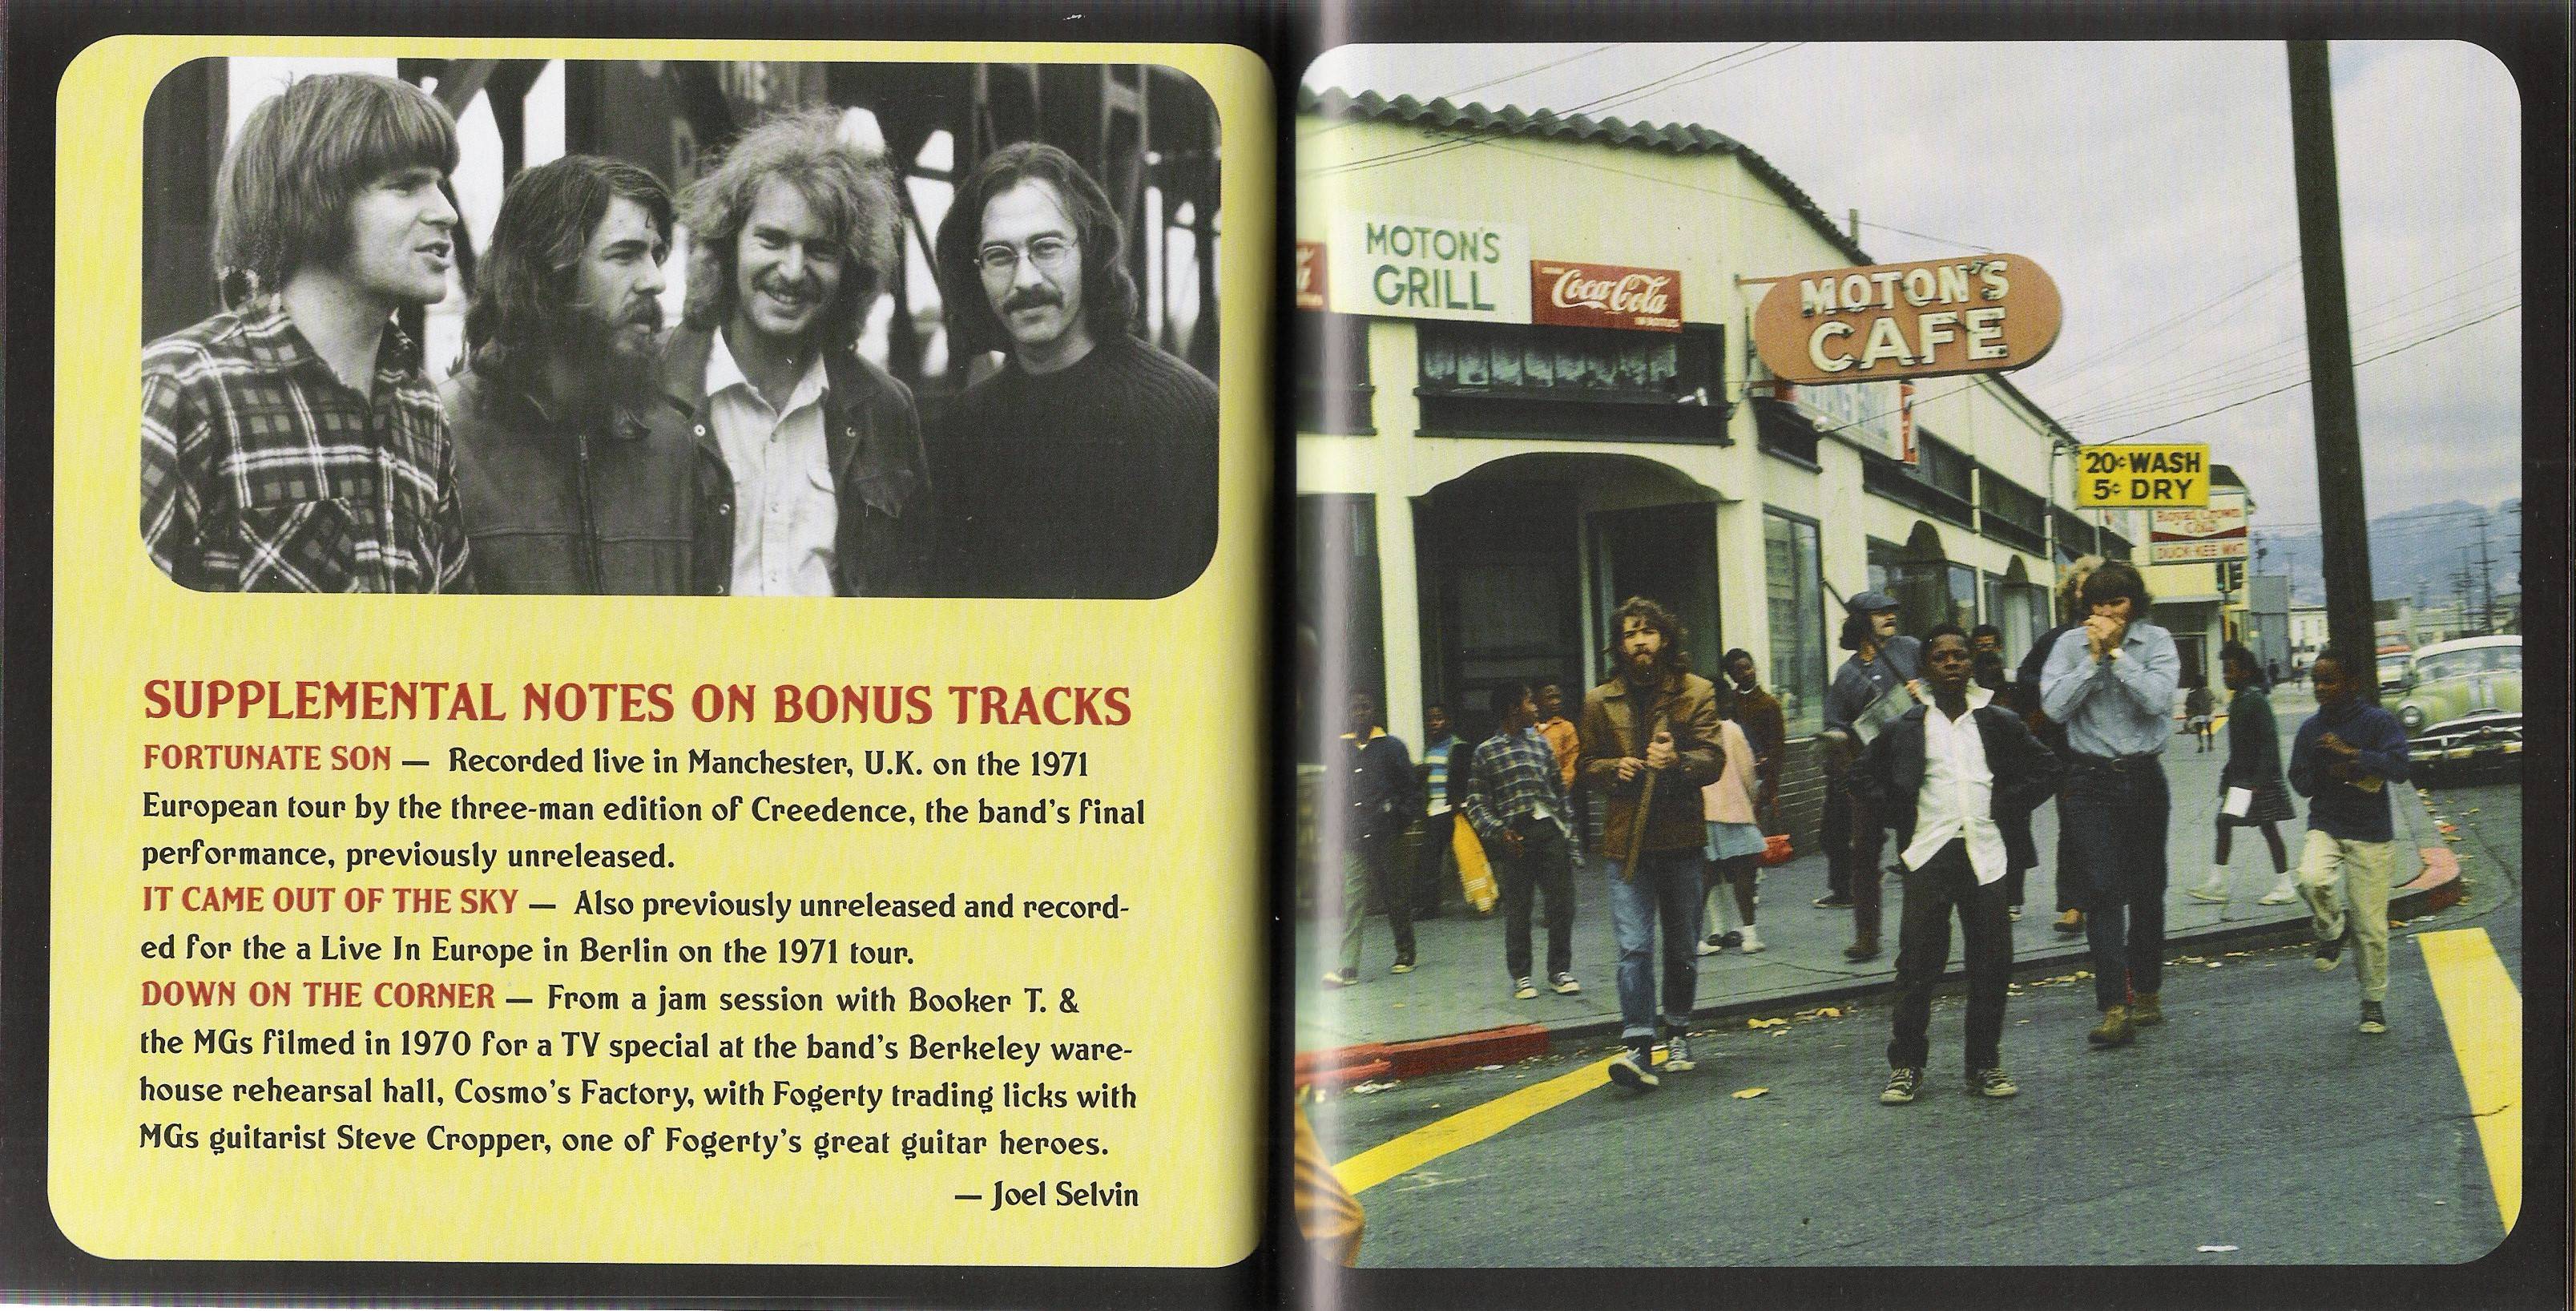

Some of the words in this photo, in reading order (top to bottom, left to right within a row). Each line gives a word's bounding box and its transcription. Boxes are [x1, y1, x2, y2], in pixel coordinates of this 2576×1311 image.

[1366, 222, 1501, 264] MOTON'S
[1373, 264, 1495, 311] GRILL
[1800, 260, 2010, 317] MOTON'S
[1808, 306, 2008, 373] CAFE
[2129, 452, 2200, 474] WASH
[2131, 479, 2193, 500] DRY
[144, 679, 506, 721] SUPPLEMENTAL
[523, 682, 675, 723] NOTES
[691, 684, 756, 723] ON
[774, 684, 933, 724] BONUS
[948, 686, 1131, 726] TRACKS
[144, 744, 321, 771] FORTUNATE
[331, 745, 392, 771] SON
[449, 747, 583, 773] Recorded
[593, 748, 645, 773] live
[653, 748, 678, 774] in
[688, 748, 853, 778] Manchester,
[865, 750, 923, 776] U.K.
[933, 758, 967, 776] on
[978, 750, 1021, 777] the
[1031, 751, 1088, 777] 1971
[143, 791, 278, 825] European
[288, 796, 346, 818] tour
[355, 793, 389, 826] by
[398, 793, 442, 820] the
[451, 793, 595, 821] three-man
[603, 795, 703, 821] edition
[712, 795, 744, 821] of
[752, 796, 915, 826] Creedence,
[925, 797, 970, 823] the
[978, 797, 1070, 825] band's
[1079, 798, 1145, 825] final
[142, 838, 335, 871] performance,
[345, 841, 498, 874] previously
[507, 841, 675, 869] unreleased.
[143, 885, 174, 911] IT
[182, 886, 264, 912] CAME
[273, 887, 336, 913] OUT
[345, 887, 385, 913] OF
[393, 888, 452, 914] THE
[461, 888, 519, 914] SKY
[573, 889, 634, 915] Also
[643, 890, 792, 924] previously
[800, 891, 956, 918] unreleased
[964, 893, 1014, 918] and
[1022, 893, 1130, 919] record-
[140, 934, 175, 959] ed
[186, 933, 232, 959] for
[243, 934, 286, 960] the
[296, 942, 312, 960] a
[321, 934, 382, 961] Live
[393, 935, 421, 961] In
[432, 936, 534, 969] Europe
[543, 936, 568, 962] in
[580, 937, 668, 963] Berlin
[679, 945, 712, 963] on
[724, 938, 768, 963] the
[778, 938, 838, 964] 1971
[850, 942, 913, 965] tour.
[142, 980, 236, 1007] DOWN
[249, 981, 292, 1007] ON
[302, 982, 362, 1008] THE
[374, 982, 496, 1009] CORNER
[548, 984, 619, 1010] From
[631, 992, 647, 1010] a
[655, 984, 707, 1017] jam
[720, 986, 823, 1011] session
[836, 986, 896, 1012] with
[909, 986, 1011, 1013] Booker
[1023, 987, 1046, 1013] T.
[1058, 987, 1080, 1014] &
[140, 1028, 184, 1054] the
[194, 1028, 253, 1055] MGs
[263, 1028, 355, 1055] filmed
[365, 1030, 391, 1055] in
[401, 1030, 471, 1056] 1970
[482, 1030, 528, 1057] for
[537, 1039, 552, 1057] a
[561, 1031, 601, 1058] TV
[609, 1032, 709, 1064] special
[719, 1035, 744, 1059] at
[754, 1032, 797, 1059] the
[806, 1033, 898, 1059] band's
[909, 1034, 1041, 1067] Berkeley
[1050, 1043, 1133, 1061] ware-
[139, 1075, 224, 1102] house
[232, 1076, 373, 1103] rehearsal
[383, 1077, 444, 1107] hall,
[454, 1078, 571, 1104] Cosmo's
[581, 1079, 695, 1112] Factory,
[703, 1079, 764, 1106] with
[773, 1080, 883, 1114] Fogerty
[892, 1081, 994, 1115] trading
[1003, 1082, 1068, 1108] licks
[1076, 1083, 1137, 1109] with
[139, 1123, 200, 1149] MGs
[209, 1123, 327, 1156] guitarist
[337, 1124, 416, 1150] Steve
[426, 1125, 551, 1158] Cropper,
[562, 1134, 614, 1152] one
[623, 1126, 655, 1152] of
[666, 1127, 802, 1160] Fogerty's
[813, 1131, 890, 1160] great
[901, 1128, 987, 1161] guitar
[999, 1129, 1108, 1156] heroes.
[990, 1180, 1046, 1212] Joel
[1055, 1180, 1139, 1207] Selvin
